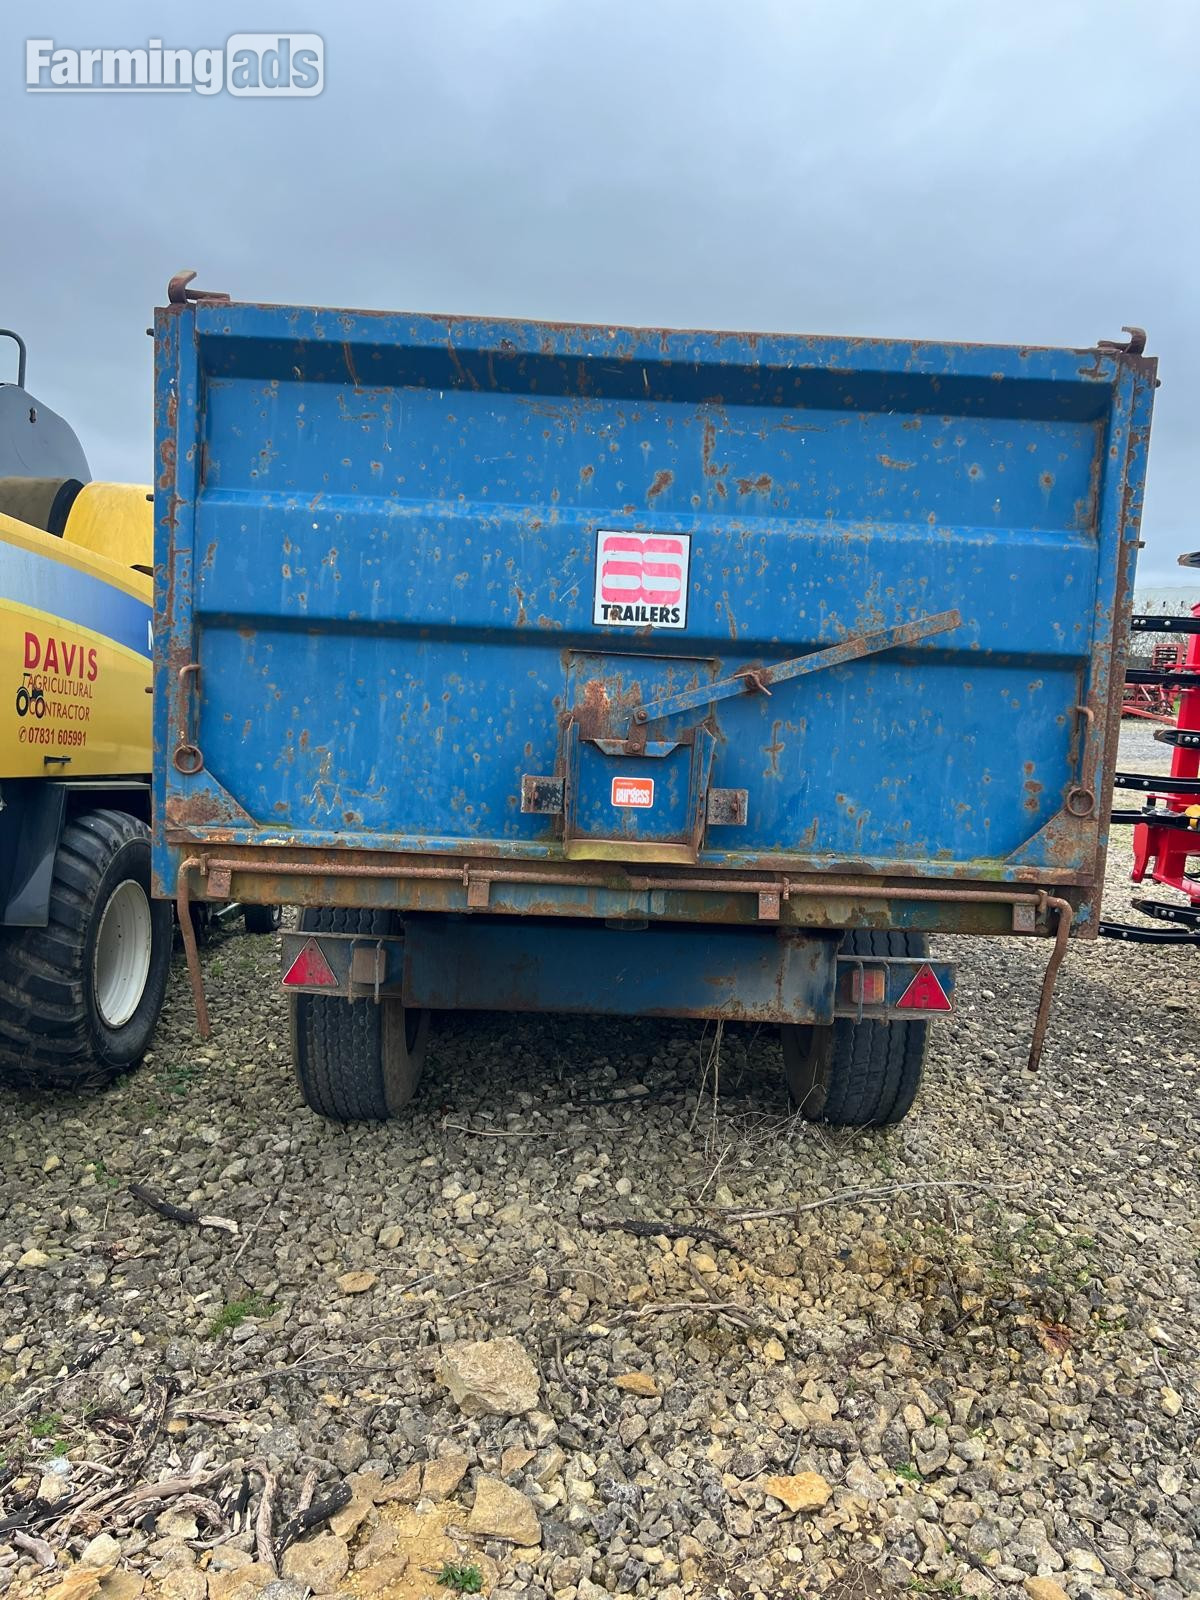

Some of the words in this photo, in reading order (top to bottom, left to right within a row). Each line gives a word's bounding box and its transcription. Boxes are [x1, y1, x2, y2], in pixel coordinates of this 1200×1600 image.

[600, 604, 681, 623] TRAILERS
[24, 631, 98, 681] DAVIS
[27, 673, 93, 699] AGRICULTURAL
[28, 727, 55, 745] 07831
[57, 729, 87, 746] 605991
